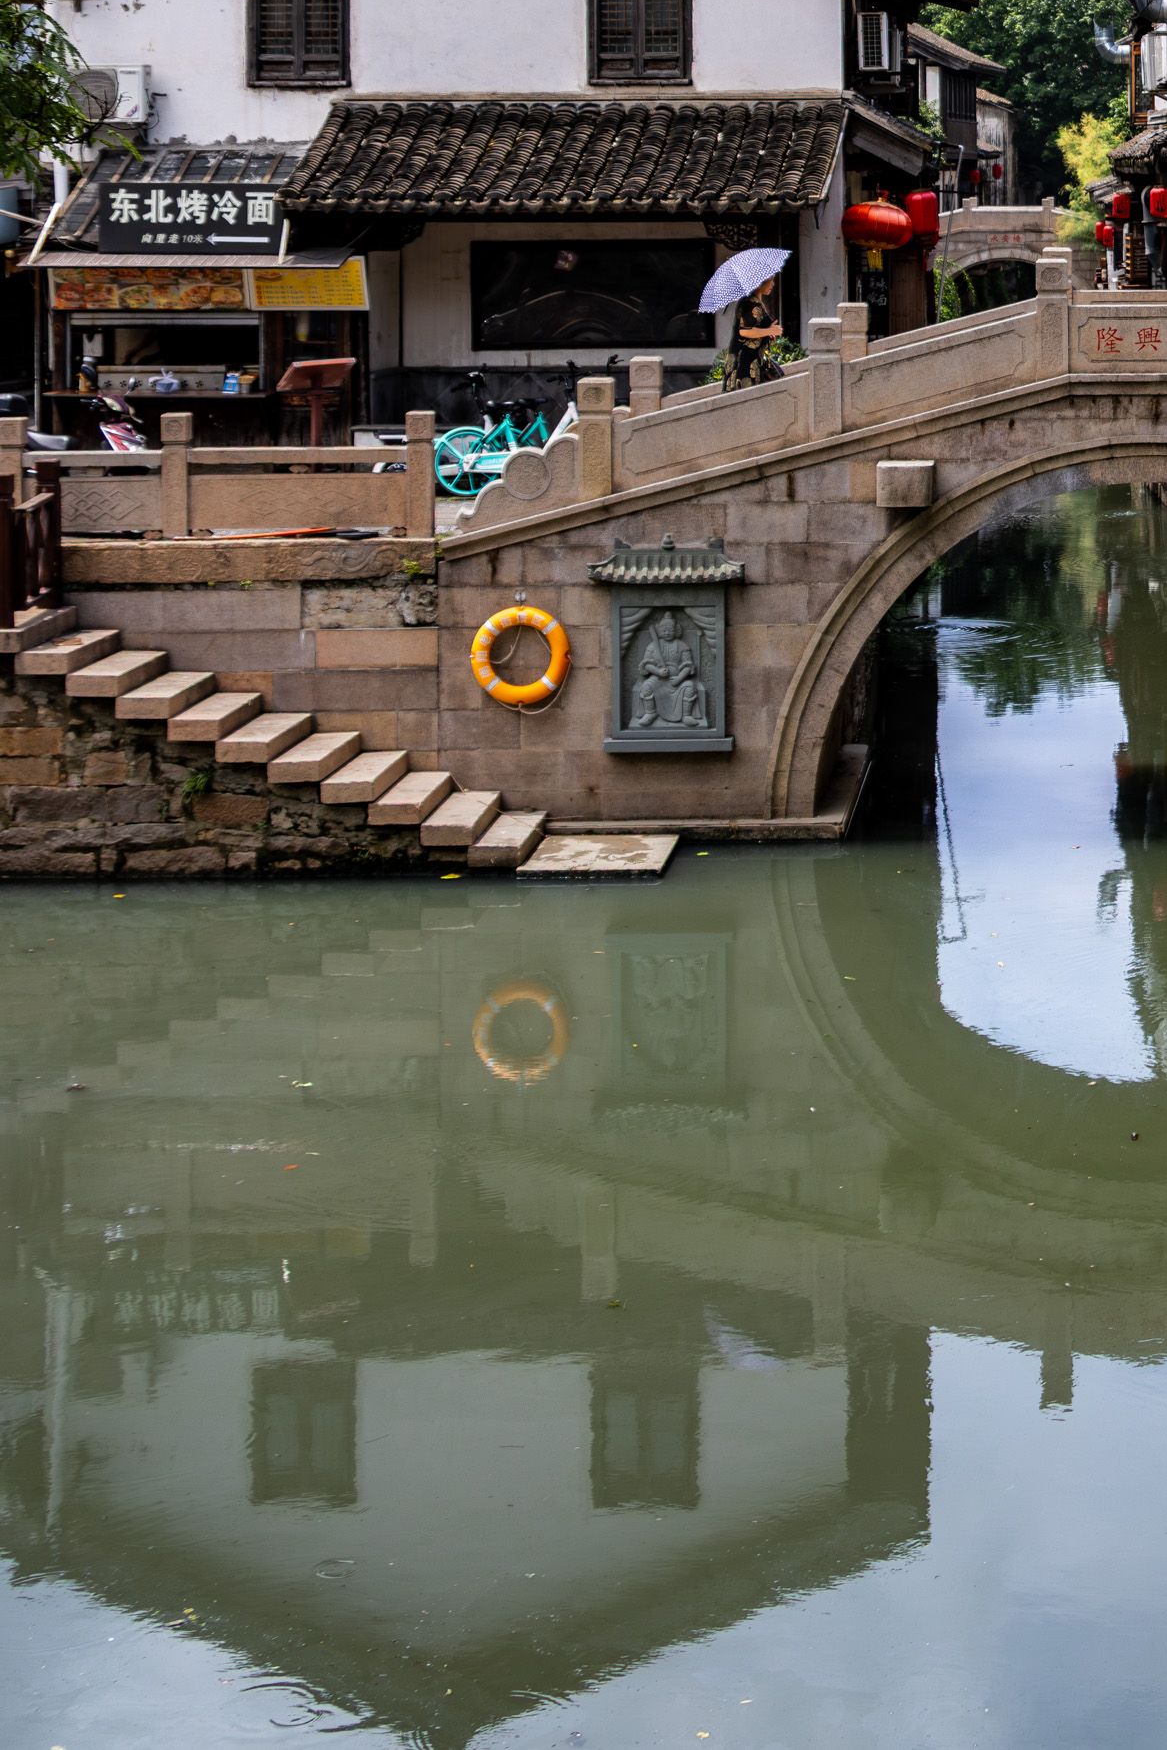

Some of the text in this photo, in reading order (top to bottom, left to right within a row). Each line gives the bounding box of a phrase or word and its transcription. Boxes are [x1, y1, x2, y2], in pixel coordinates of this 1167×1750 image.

[109, 188, 275, 225] 东北烤冷面
